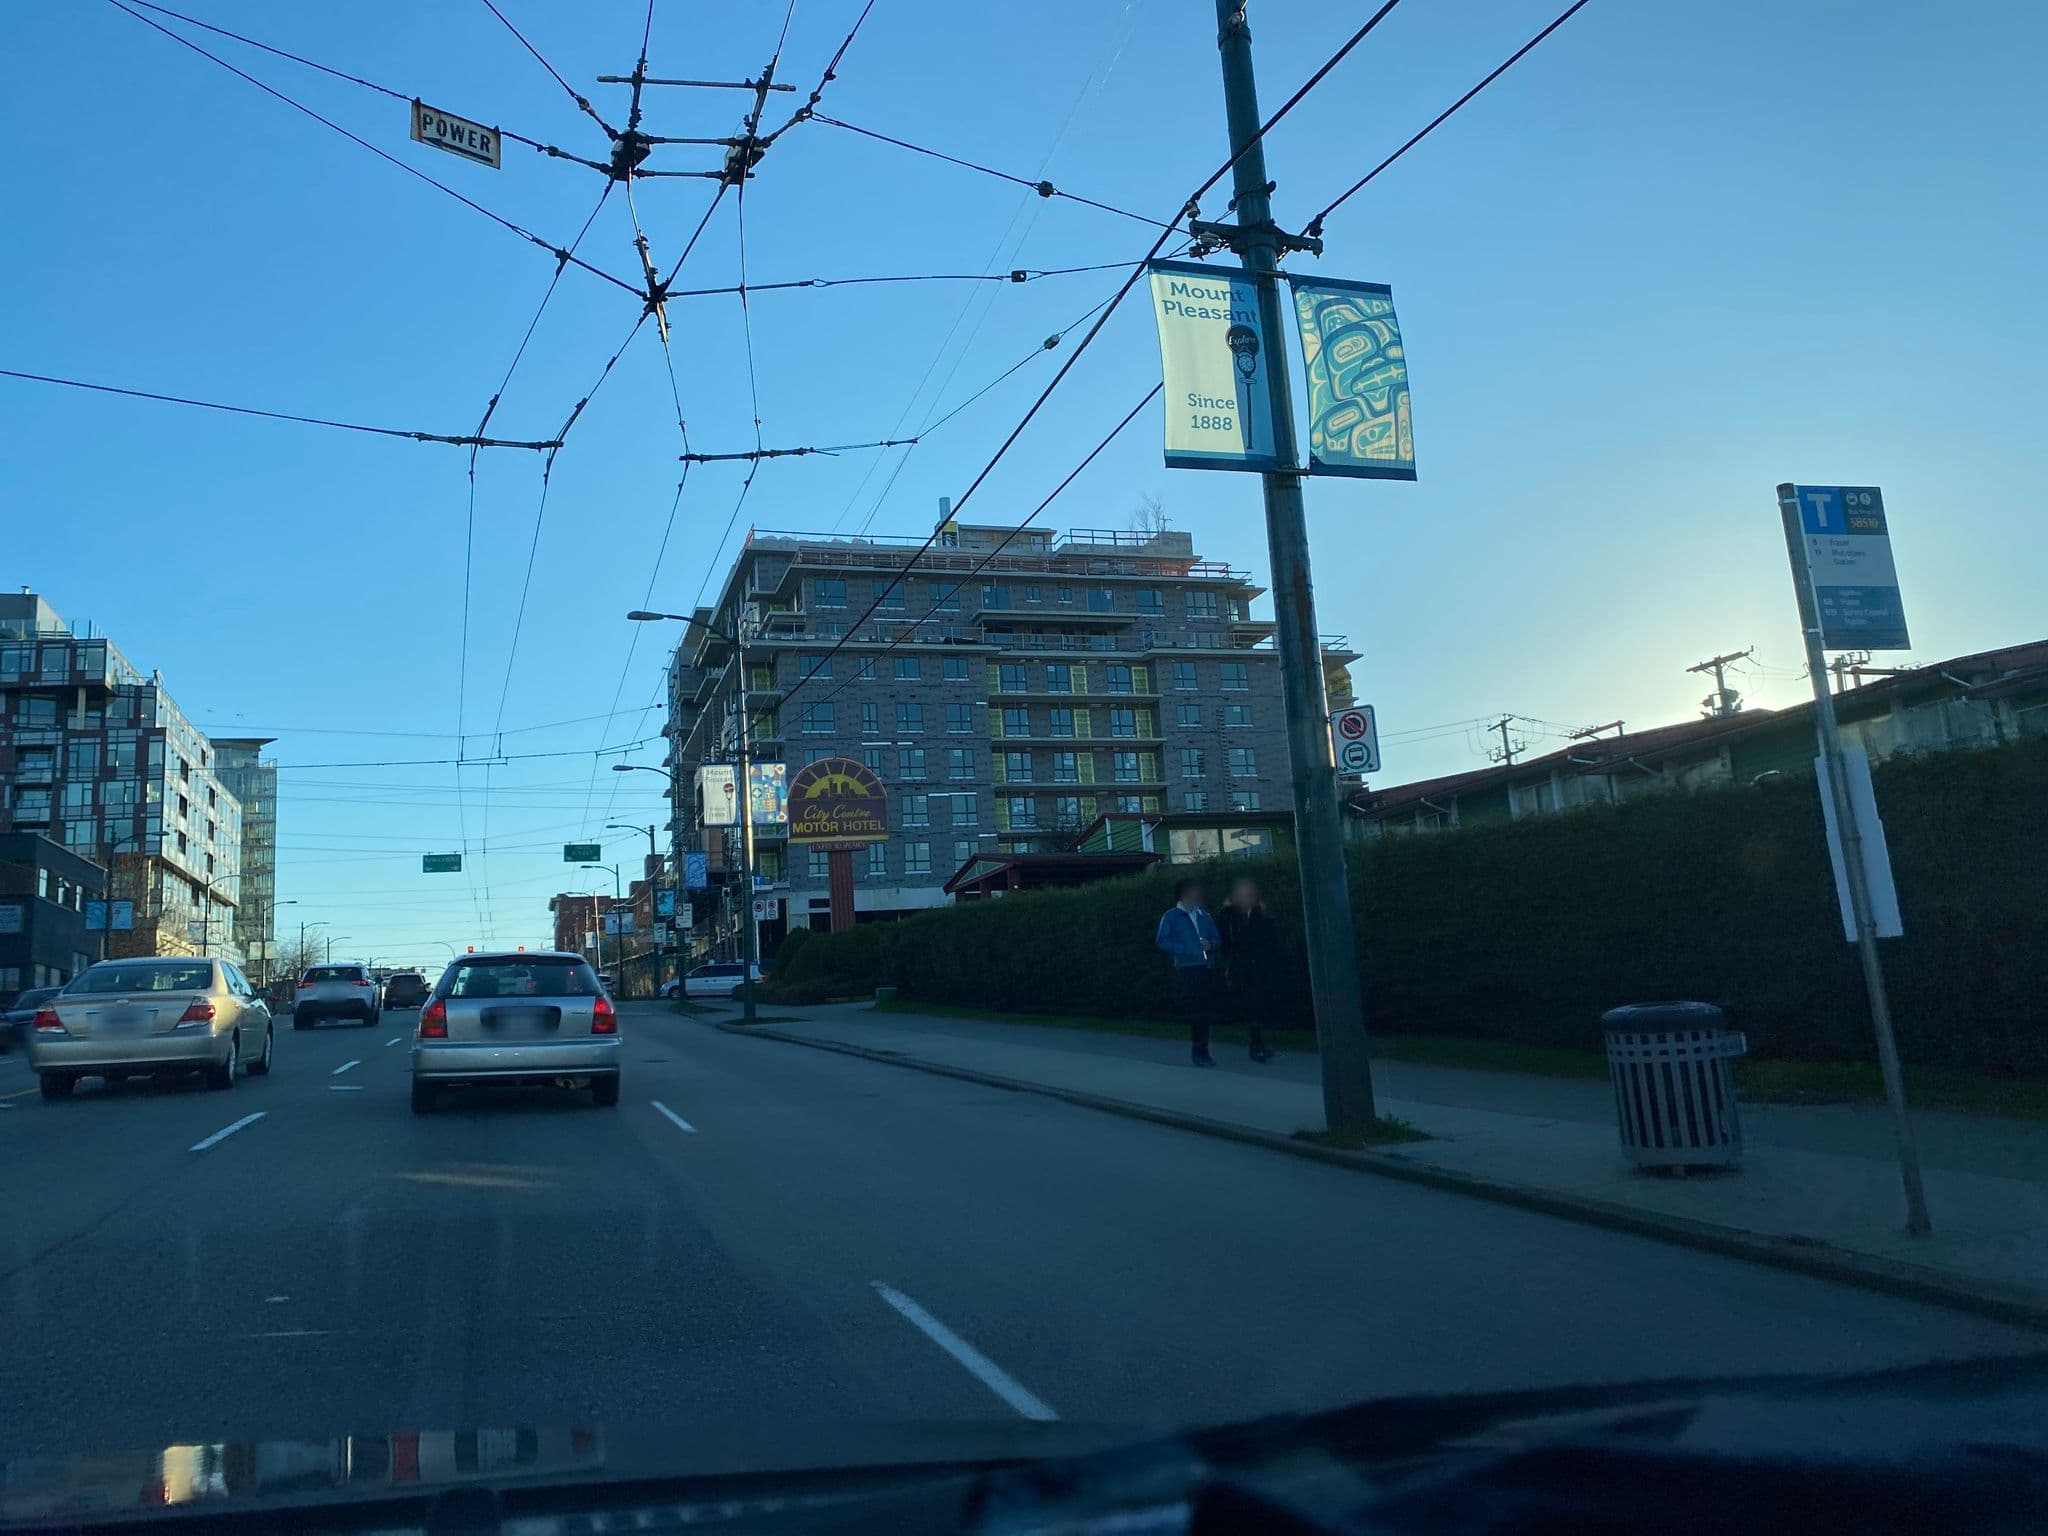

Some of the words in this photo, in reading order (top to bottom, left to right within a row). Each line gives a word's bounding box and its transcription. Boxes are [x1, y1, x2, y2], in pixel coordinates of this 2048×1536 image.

[422, 113, 491, 153] POWER
[1170, 281, 1245, 303] Mount
[1162, 299, 1258, 323] Pleasant
[1187, 393, 1235, 410] Since
[1191, 414, 1233, 431] 1888
[803, 805, 830, 822] City
[792, 821, 839, 833] MOTOR
[843, 819, 886, 832] HOTEL
